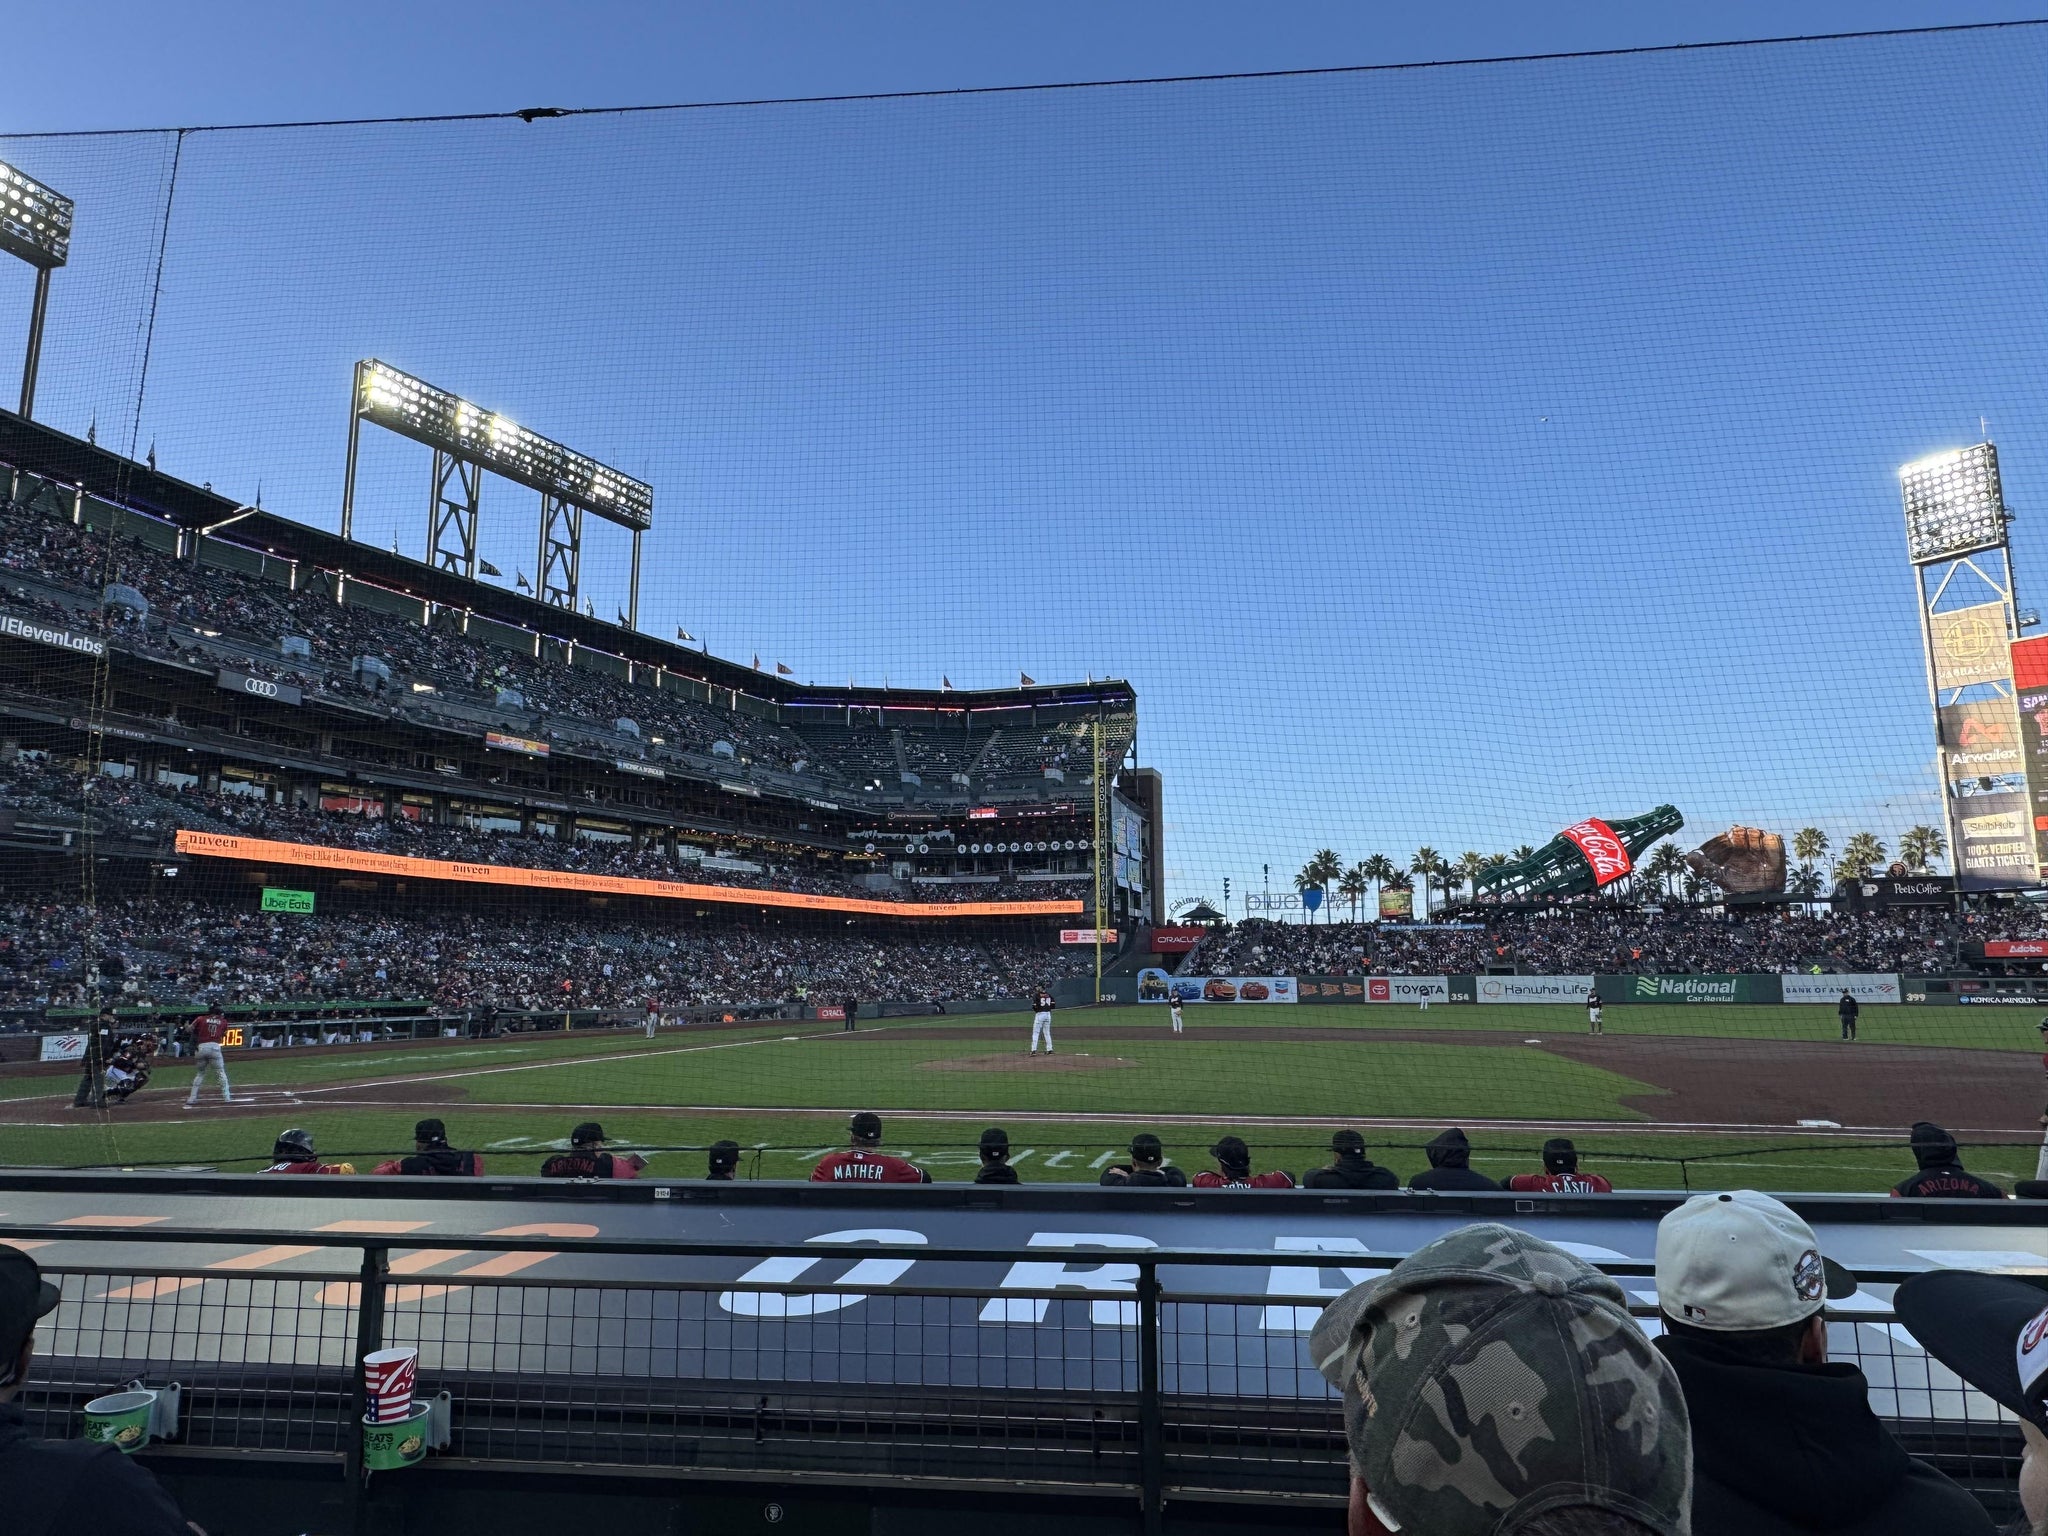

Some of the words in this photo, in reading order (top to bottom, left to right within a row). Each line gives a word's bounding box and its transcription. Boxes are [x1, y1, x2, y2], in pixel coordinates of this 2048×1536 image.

[1951, 748, 2018, 765] Airwallex
[1970, 820, 2016, 832] StubHub
[189, 834, 238, 848] nuveen
[1966, 845, 1989, 857] 100%
[1989, 842, 2027, 855] VERIFIED
[1965, 856, 1996, 869] GIANTS
[1996, 854, 2032, 867] TICKETS
[452, 864, 490, 875] nuveen
[1916, 883, 1942, 895] Coffee
[265, 897, 287, 909] Uber
[288, 898, 311, 910] Eats
[1245, 891, 1299, 910] blue
[1157, 935, 1200, 943] ORACLE
[2007, 944, 2042, 953] Adobe
[1504, 984, 1560, 995] Hanwha
[1562, 984, 1590, 995] Life
[1660, 979, 1737, 994] National
[1100, 994, 1117, 1002] 339
[1686, 994, 1703, 1002] Car
[1703, 994, 1734, 1002] Rental
[1906, 993, 1926, 1002] 399
[1970, 996, 2000, 1004] KONICA
[2002, 996, 2037, 1004] MINOLTA
[822, 1009, 845, 1017] ORACL
[550, 1158, 595, 1173] ARIZONA
[834, 1164, 884, 1180] MATHER
[1917, 1178, 1980, 1197] ARIZONA
[369, 1432, 394, 1443] EATS
